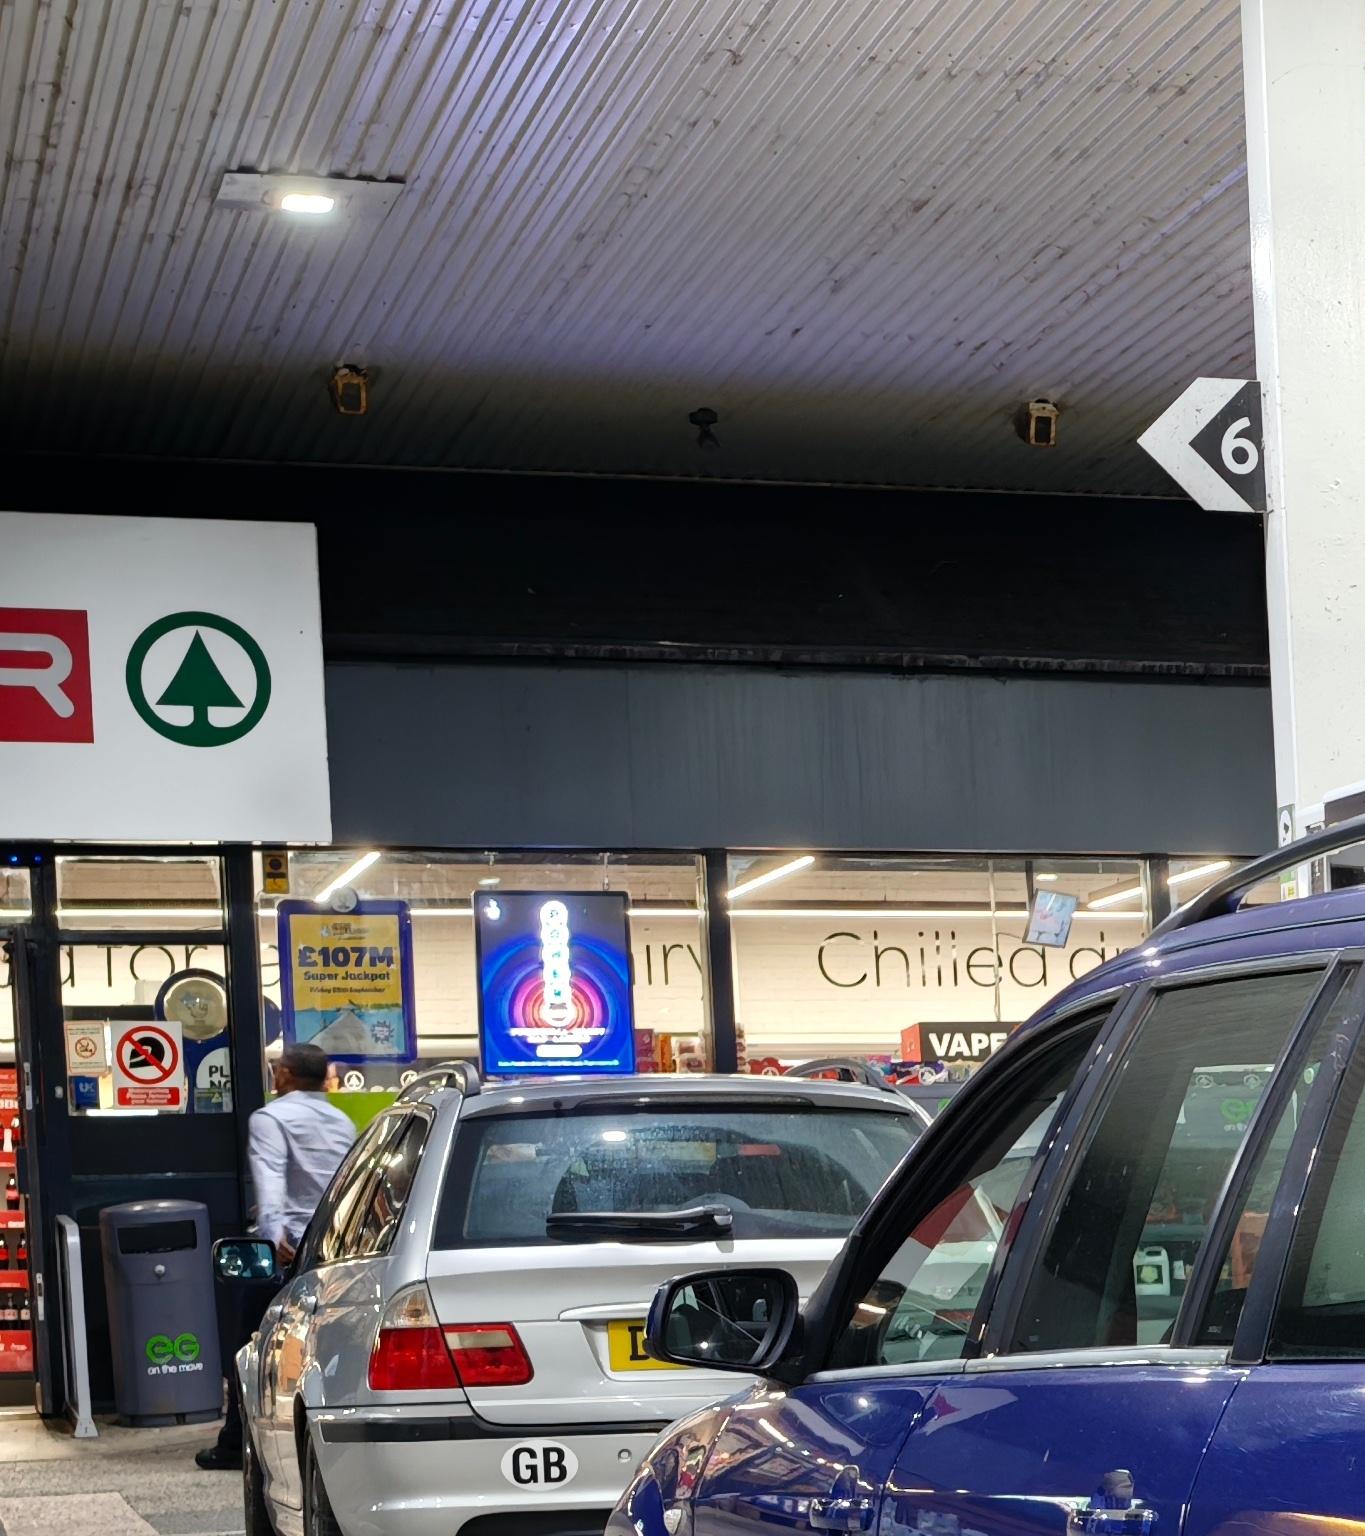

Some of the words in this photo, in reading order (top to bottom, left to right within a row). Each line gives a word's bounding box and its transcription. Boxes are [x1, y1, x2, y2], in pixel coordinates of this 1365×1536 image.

[1220, 416, 1259, 475] 6
[298, 945, 395, 968] £107M
[818, 930, 1048, 987] Chilled
[303, 970, 338, 982] Super
[341, 970, 390, 982] Jackpot
[147, 1366, 161, 1376] on
[161, 1364, 178, 1375] the
[178, 1362, 204, 1373] move
[512, 1446, 568, 1485] GB
